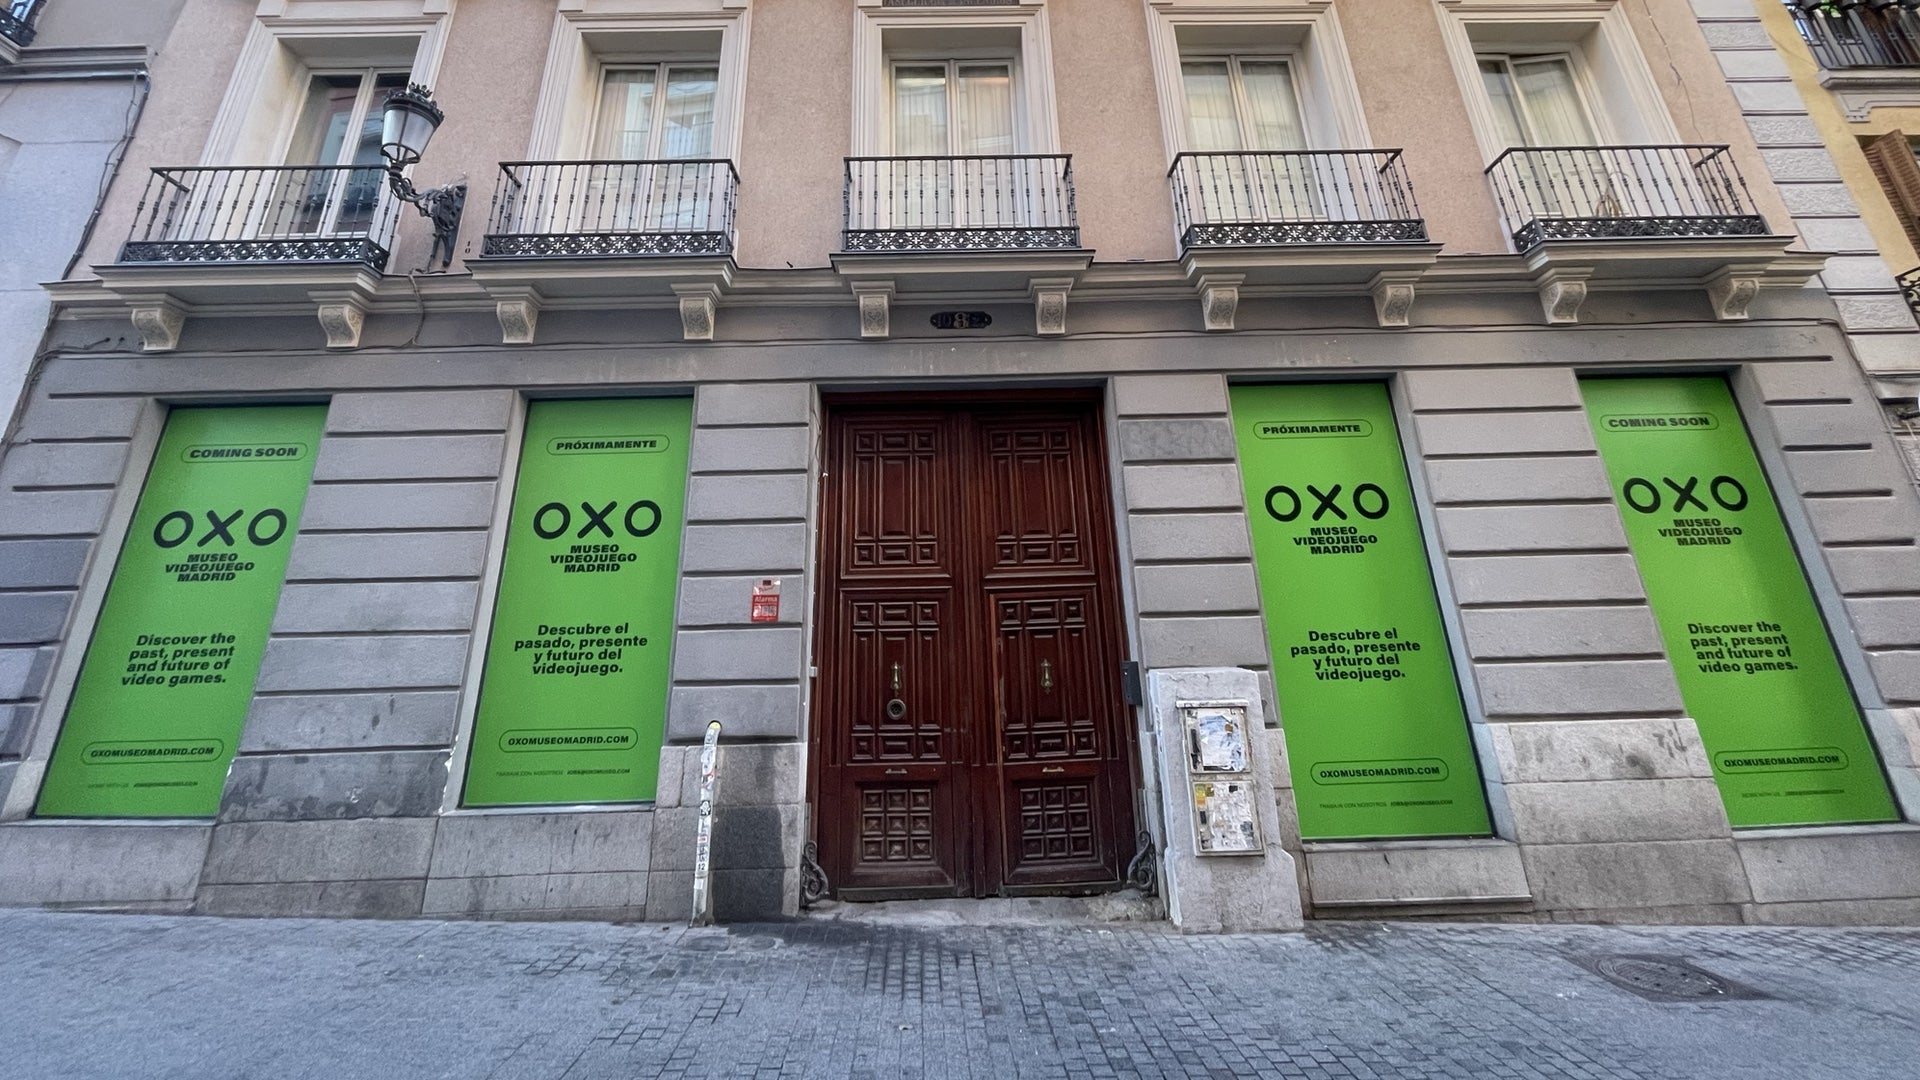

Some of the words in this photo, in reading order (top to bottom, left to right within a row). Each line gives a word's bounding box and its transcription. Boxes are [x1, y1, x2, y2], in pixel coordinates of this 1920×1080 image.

[1608, 418, 1667, 428] COMING
[1669, 417, 1710, 426] SOON
[1263, 425, 1361, 434] PRÓXIMAMENTE
[556, 440, 657, 450] PRÓXIMAMENTE
[190, 448, 252, 458] COMING
[255, 447, 298, 457] SOON
[1623, 476, 1748, 514] OXO
[1265, 483, 1389, 522] OXO
[533, 500, 662, 539] OXO
[1673, 518, 1722, 527] MUSEO
[153, 508, 288, 548] OXO
[1310, 526, 1358, 536] MUSEO
[1658, 527, 1743, 537] VIDEOJUEGO
[1293, 535, 1378, 546] VIDEOJUEGO
[1676, 536, 1731, 546] MADRID
[570, 544, 619, 553] MUSEO
[1310, 545, 1365, 554] MADRID
[187, 553, 238, 562] MUSEO
[550, 553, 637, 563] VIDEOJUEGO
[165, 562, 255, 573] VIDEOJUEGO
[564, 563, 620, 573] MADRID
[177, 572, 236, 582] MADRID
[537, 623, 611, 635] Descubre
[615, 622, 629, 634] el
[1687, 623, 1753, 634] Discover
[1756, 621, 1782, 632] the
[136, 634, 208, 646] Discover
[210, 633, 236, 644] the
[1308, 629, 1381, 641] Descubre
[1384, 627, 1398, 639] el
[514, 637, 575, 651] pasado,
[579, 636, 648, 650] presente
[1690, 636, 1728, 650] past,
[1730, 633, 1788, 648] present
[129, 648, 168, 662] past,
[172, 646, 235, 660] present
[1290, 643, 1350, 658] pasado,
[1353, 641, 1421, 655] presente
[1696, 648, 1725, 660] and
[1727, 647, 1773, 659] future
[1777, 646, 1791, 657] of
[533, 652, 543, 664] y
[546, 650, 594, 661] futuro
[598, 648, 622, 660] del
[1313, 658, 1322, 670] y
[1325, 655, 1373, 667] futuro
[1376, 653, 1400, 665] del
[127, 661, 158, 672] and
[161, 660, 210, 671] future
[213, 658, 231, 669] of
[532, 662, 622, 676] videojuego.
[1698, 661, 1741, 673] video
[1744, 661, 1799, 675] games.
[122, 674, 165, 685] video
[168, 674, 226, 687] games.
[1315, 667, 1406, 682] videojuego.
[508, 735, 629, 746] OXOMUSEOMADRID.COM
[90, 747, 215, 758] OXOMUSEOMADRID.COM
[1724, 755, 1840, 767] OXOMUSEOMADRID.COM
[1319, 766, 1440, 778] OXOMUSEOMADRID.COM
